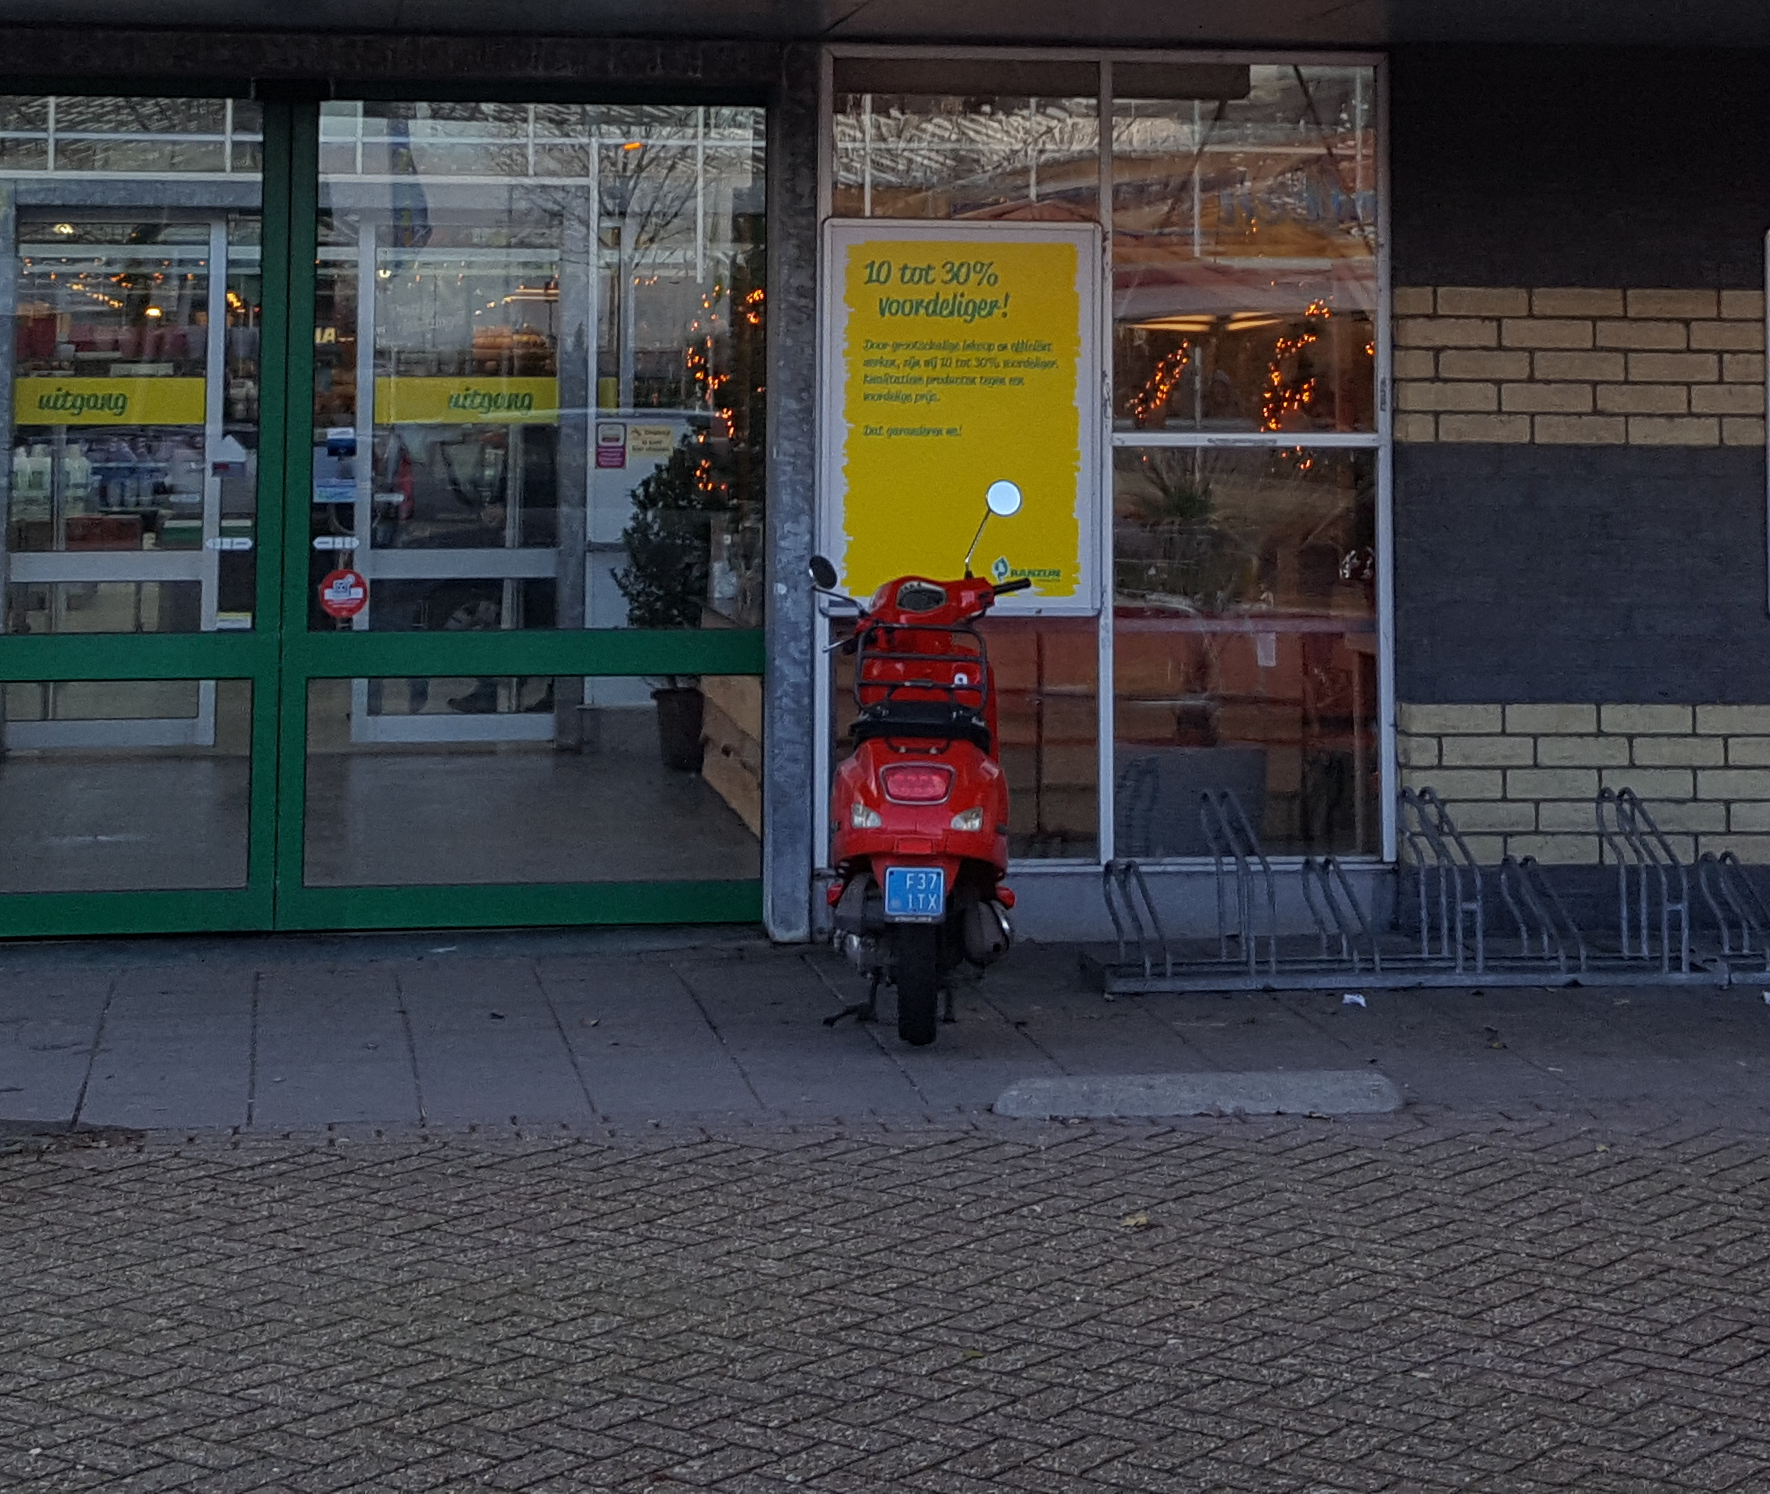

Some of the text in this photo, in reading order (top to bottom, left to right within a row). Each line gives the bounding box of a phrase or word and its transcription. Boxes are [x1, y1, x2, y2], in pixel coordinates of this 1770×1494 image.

[863, 260, 999, 286] 10 tot 30%
[879, 291, 1010, 324] voordeliger!
[38, 387, 128, 416] uitgang
[448, 387, 534, 416] uitgang
[906, 873, 937, 889] F37
